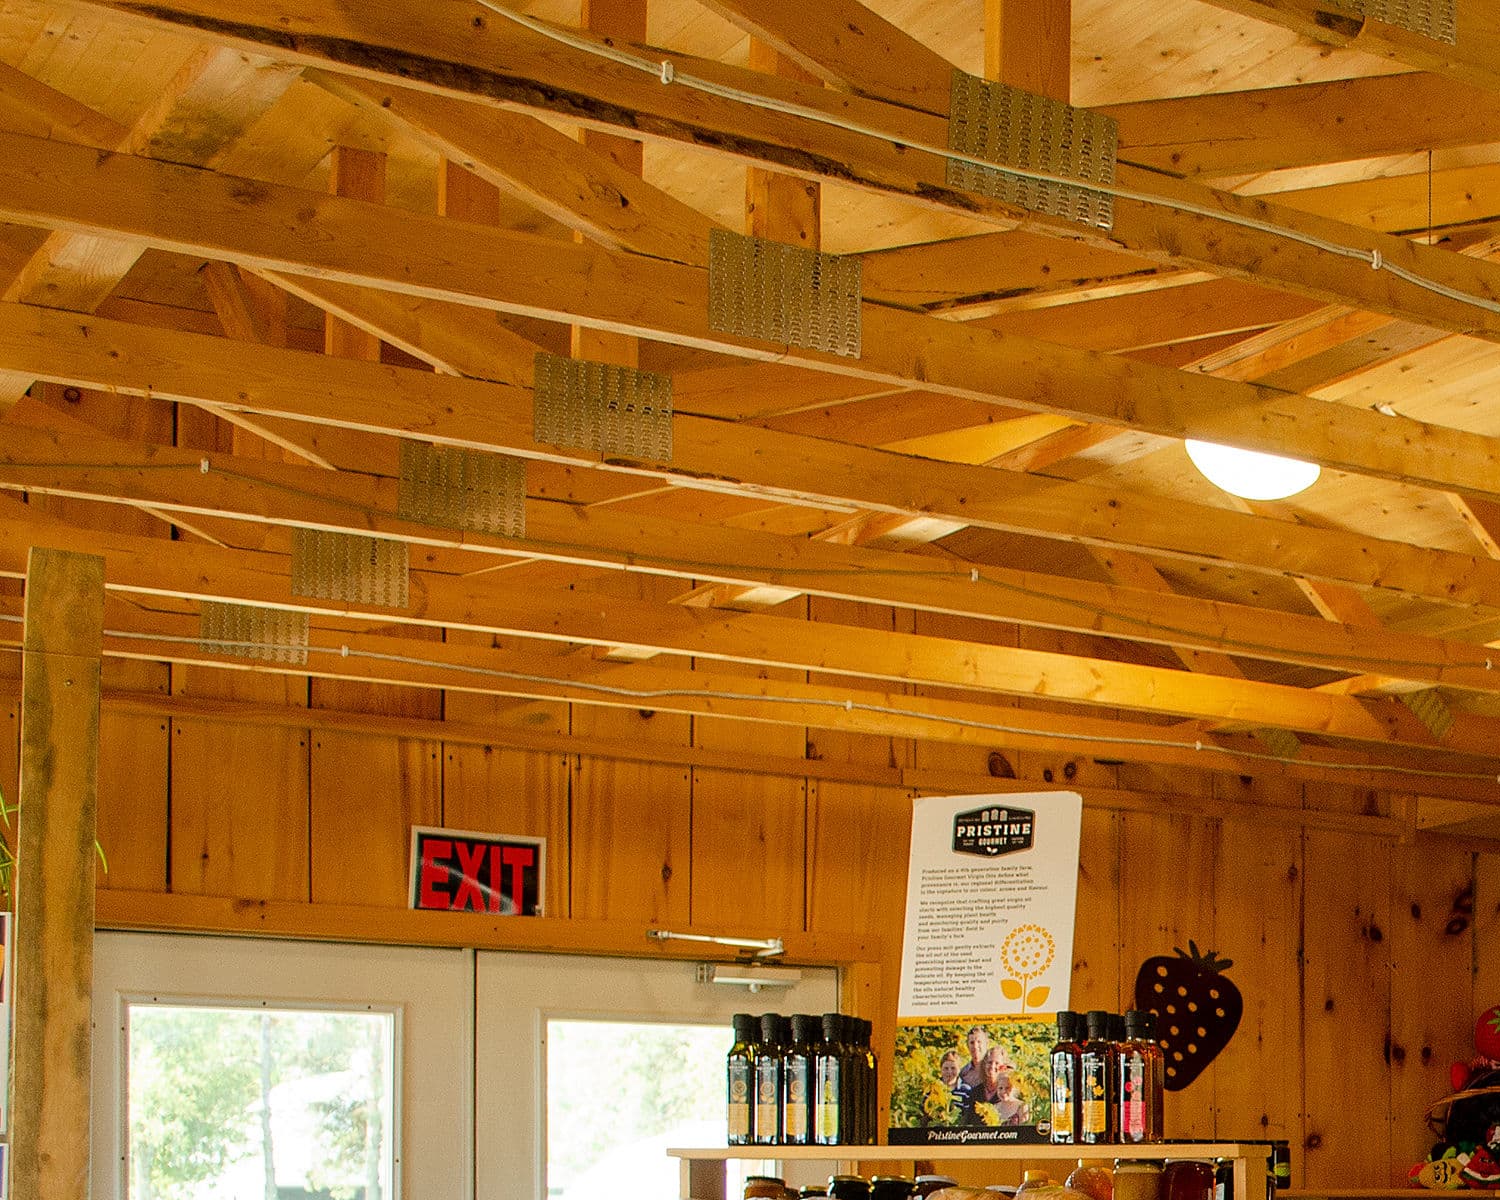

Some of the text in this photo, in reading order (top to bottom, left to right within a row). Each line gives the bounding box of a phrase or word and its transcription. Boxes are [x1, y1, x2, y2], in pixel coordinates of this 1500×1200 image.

[957, 823, 1031, 837] PRISTINE
[420, 840, 533, 916] EXIT
[928, 1130, 1018, 1143] PristineGourmet.com
